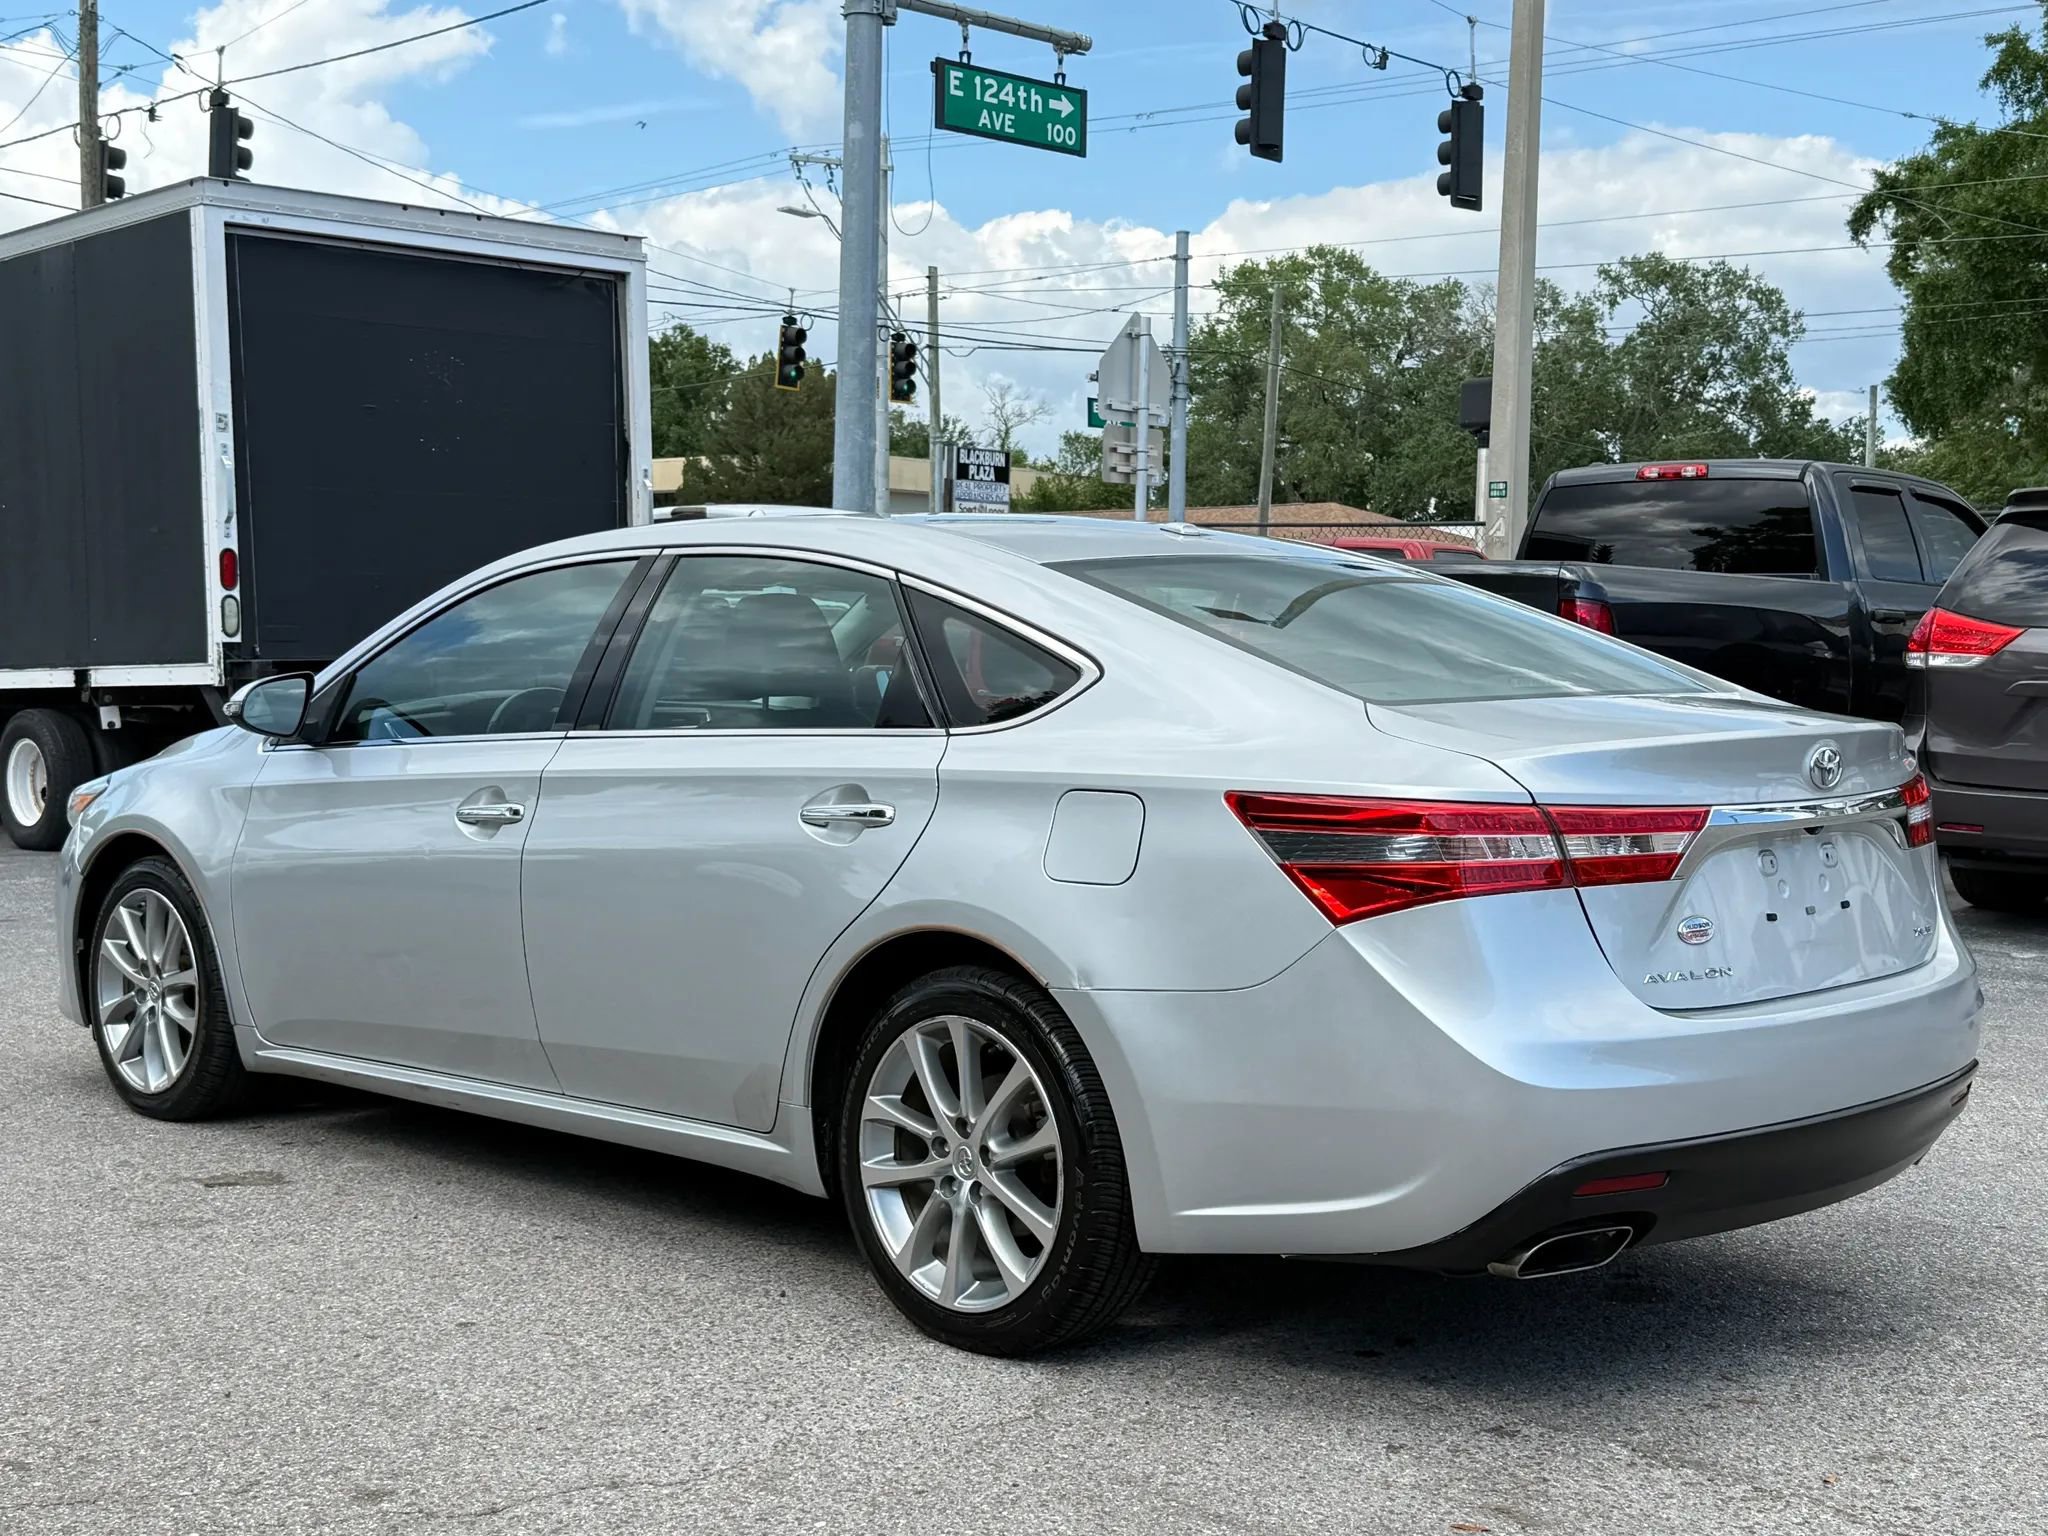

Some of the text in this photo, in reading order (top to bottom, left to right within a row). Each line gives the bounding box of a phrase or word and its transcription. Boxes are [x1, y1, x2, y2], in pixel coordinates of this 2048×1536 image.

[949, 70, 1043, 114] E 124th
[978, 109, 1015, 134] AVE
[1046, 123, 1076, 146] 100
[959, 449, 1006, 467] BLACKBURN
[968, 465, 996, 481] PLAZA
[1643, 967, 1734, 984] AVALON
